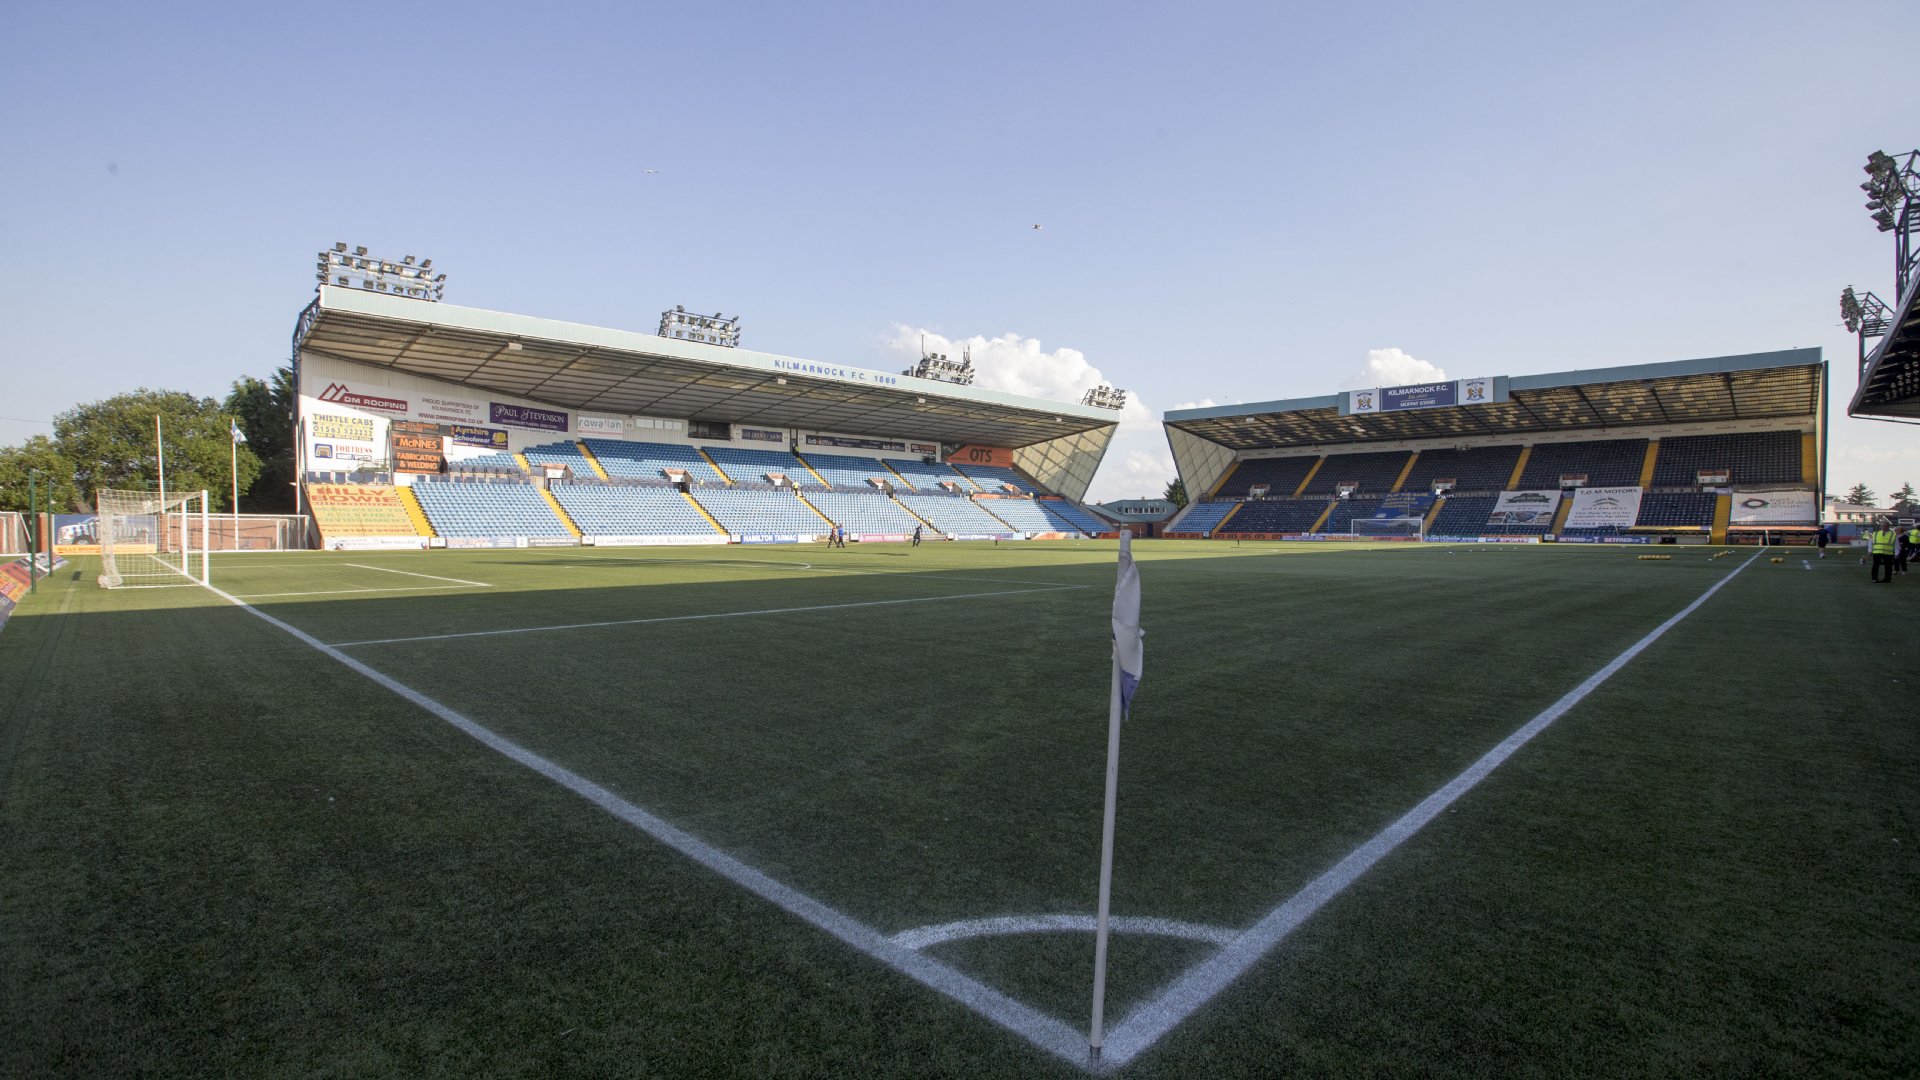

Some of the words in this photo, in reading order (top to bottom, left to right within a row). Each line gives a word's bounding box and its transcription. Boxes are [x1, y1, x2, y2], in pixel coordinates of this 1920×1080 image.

[774, 360, 845, 377] KILMARNOCK
[1388, 386, 1435, 396] KILMARNOCK
[344, 396, 361, 404] DM
[363, 399, 406, 410] ROOFING
[422, 397, 440, 405] PROUD
[441, 400, 472, 410] SUPPORTERS
[432, 405, 464, 414] KILMARNOCK
[495, 405, 518, 417] PAUL
[521, 409, 565, 423] STEVENSON
[313, 413, 349, 423] THISTLE
[351, 417, 374, 426] CABS
[578, 419, 622, 429] rowallan
[456, 426, 489, 436] Ayrshire
[400, 437, 437, 449] McINNES
[454, 434, 490, 443] Schoolwear
[336, 444, 373, 454] FORTRESS
[397, 452, 440, 462] FABRICATION
[969, 448, 993, 462] QTS
[407, 461, 438, 470] WELDING
[316, 488, 385, 496] BILLY
[311, 495, 399, 503] BOWIE
[744, 534, 772, 542] HAMILTON
